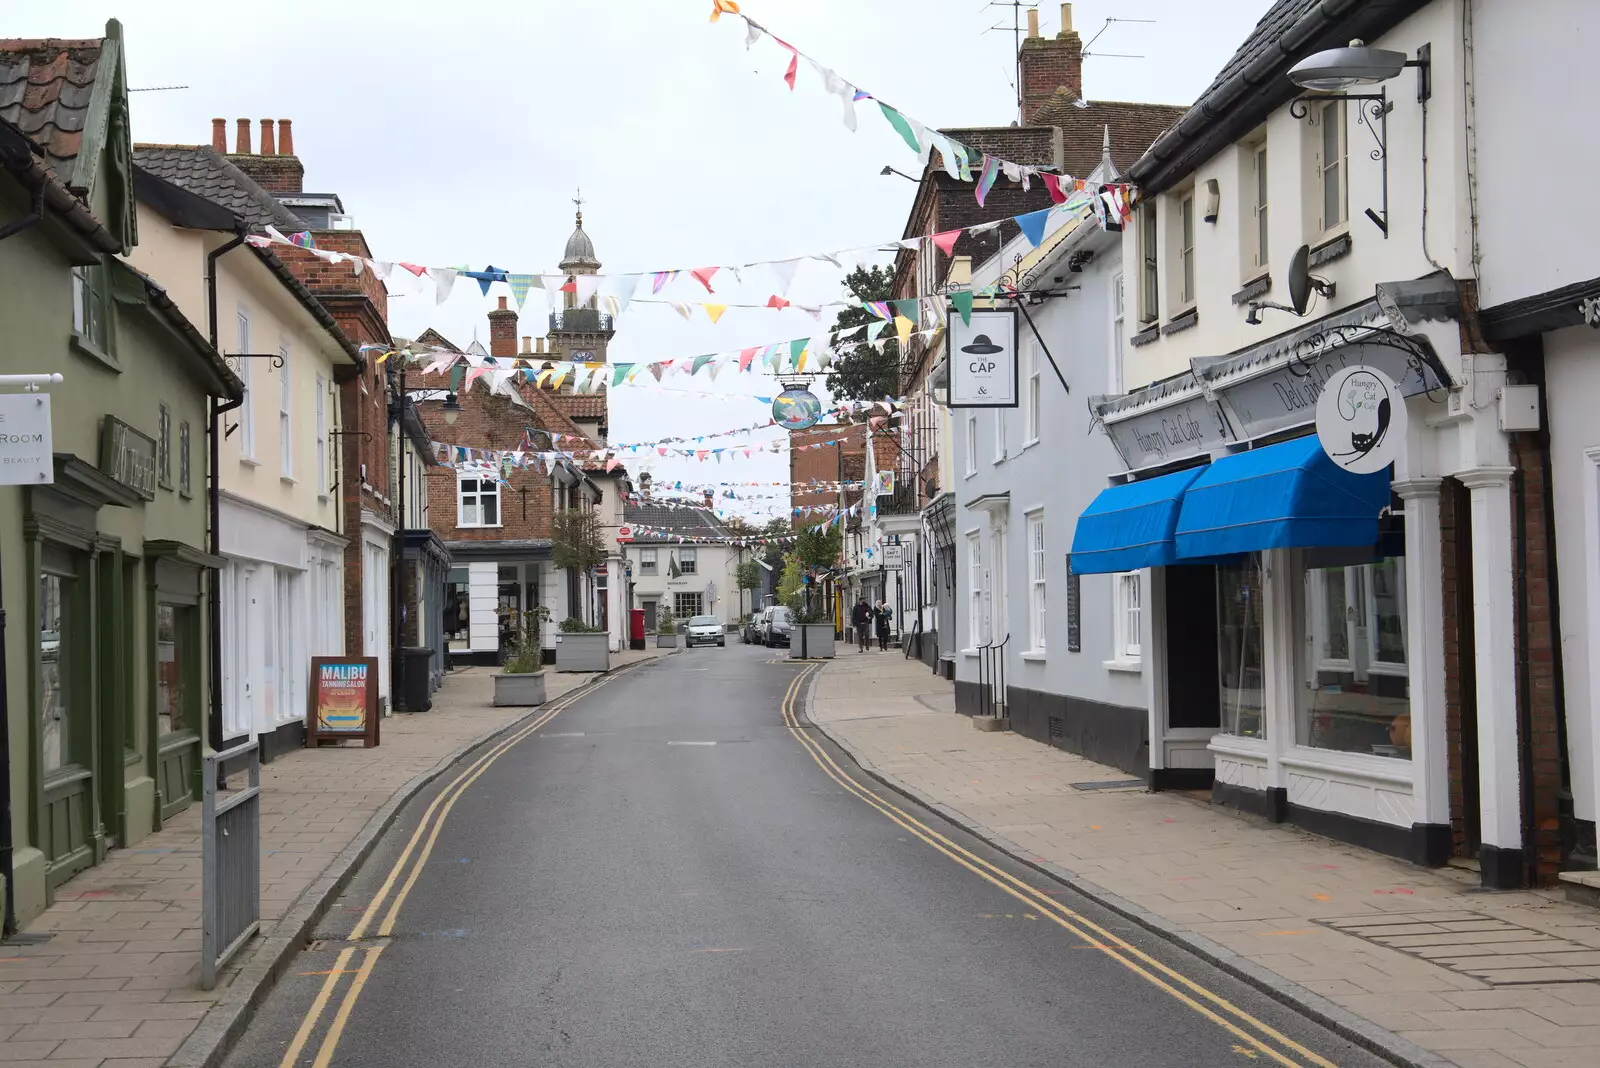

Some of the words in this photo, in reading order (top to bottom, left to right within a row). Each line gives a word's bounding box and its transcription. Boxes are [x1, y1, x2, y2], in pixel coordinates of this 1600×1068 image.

[969, 362, 996, 373] CAP
[1351, 379, 1377, 391] Hungry
[1273, 375, 1308, 411] Deli
[1364, 392, 1376, 400] Cat
[0, 433, 42, 443] ROOM
[1132, 428, 1169, 460] Hungry
[1162, 419, 1183, 446] Cat
[1177, 407, 1204, 450] Cafe
[322, 666, 366, 680] MALIBU
[322, 680, 346, 688] TANNING
[346, 680, 365, 688] SALON
